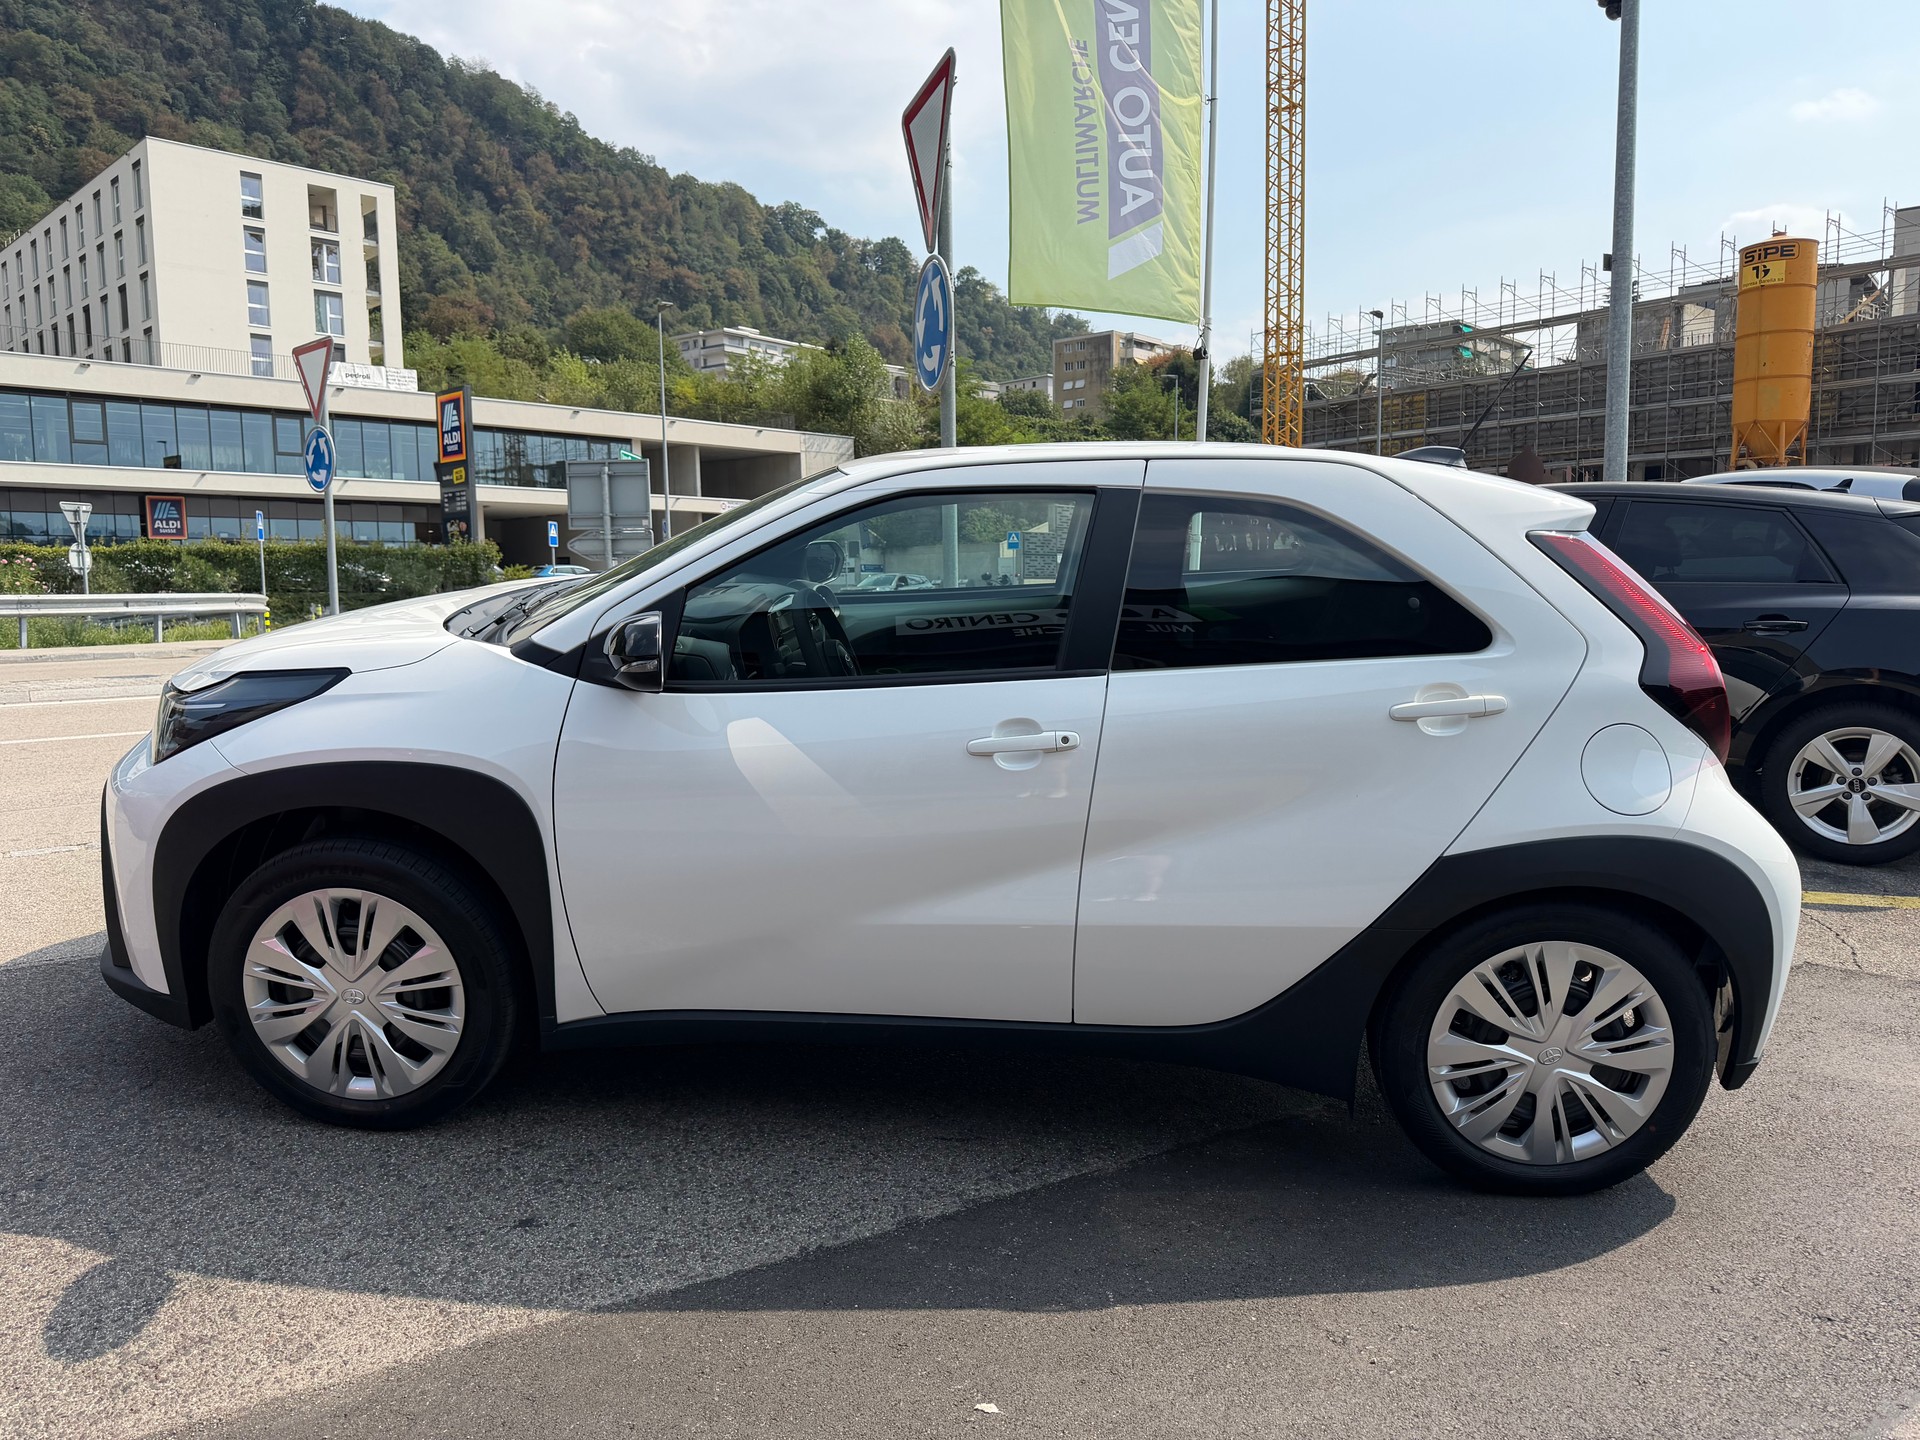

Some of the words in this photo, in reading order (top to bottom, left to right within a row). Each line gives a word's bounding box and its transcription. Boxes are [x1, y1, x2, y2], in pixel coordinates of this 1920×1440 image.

[345, 372, 371, 380] pedroli
[443, 430, 461, 446] ALDI
[154, 520, 181, 529] ALDI
